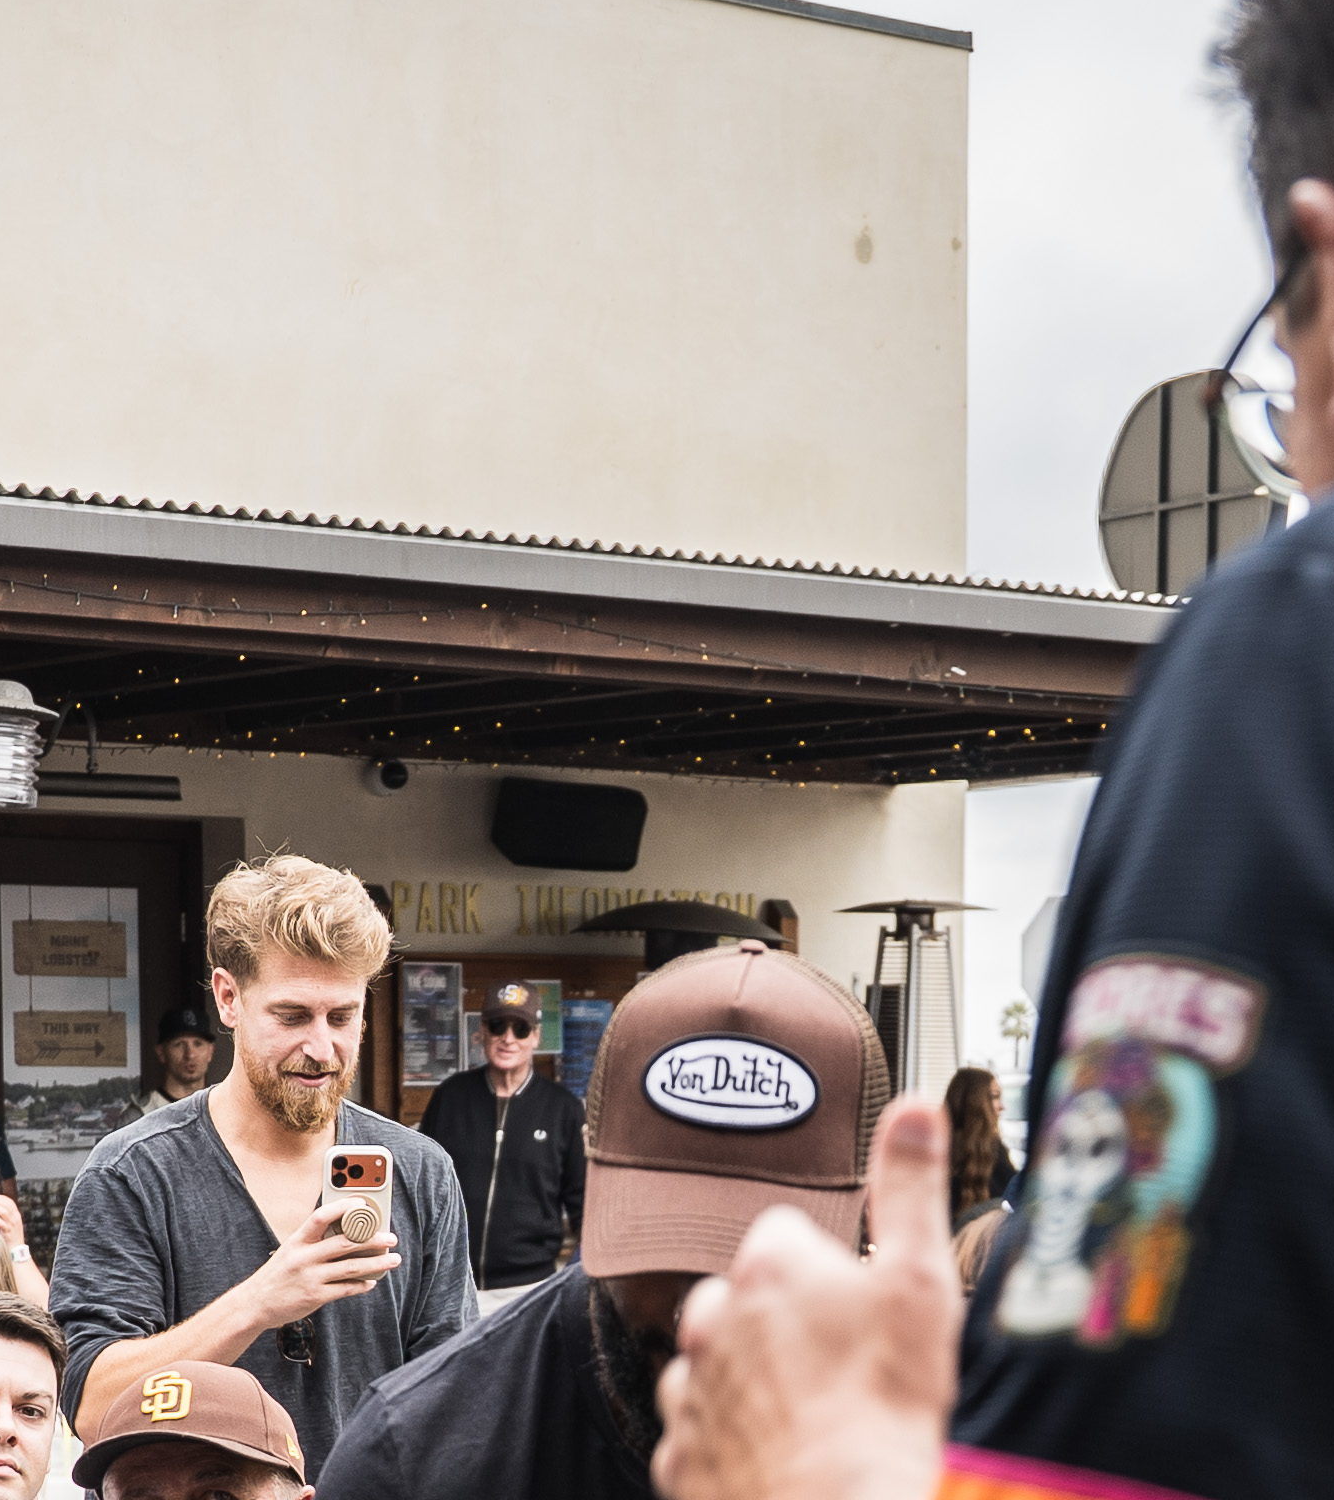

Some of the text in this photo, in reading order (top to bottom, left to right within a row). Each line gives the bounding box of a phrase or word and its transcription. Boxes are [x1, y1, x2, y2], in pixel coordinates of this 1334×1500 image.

[392, 880, 484, 934] PARK
[42, 953, 99, 967] LOBSTER
[42, 1022, 101, 1034] THIS WAY
[668, 1054, 791, 1103] Von Dutch
[140, 1370, 193, 1423] SD
